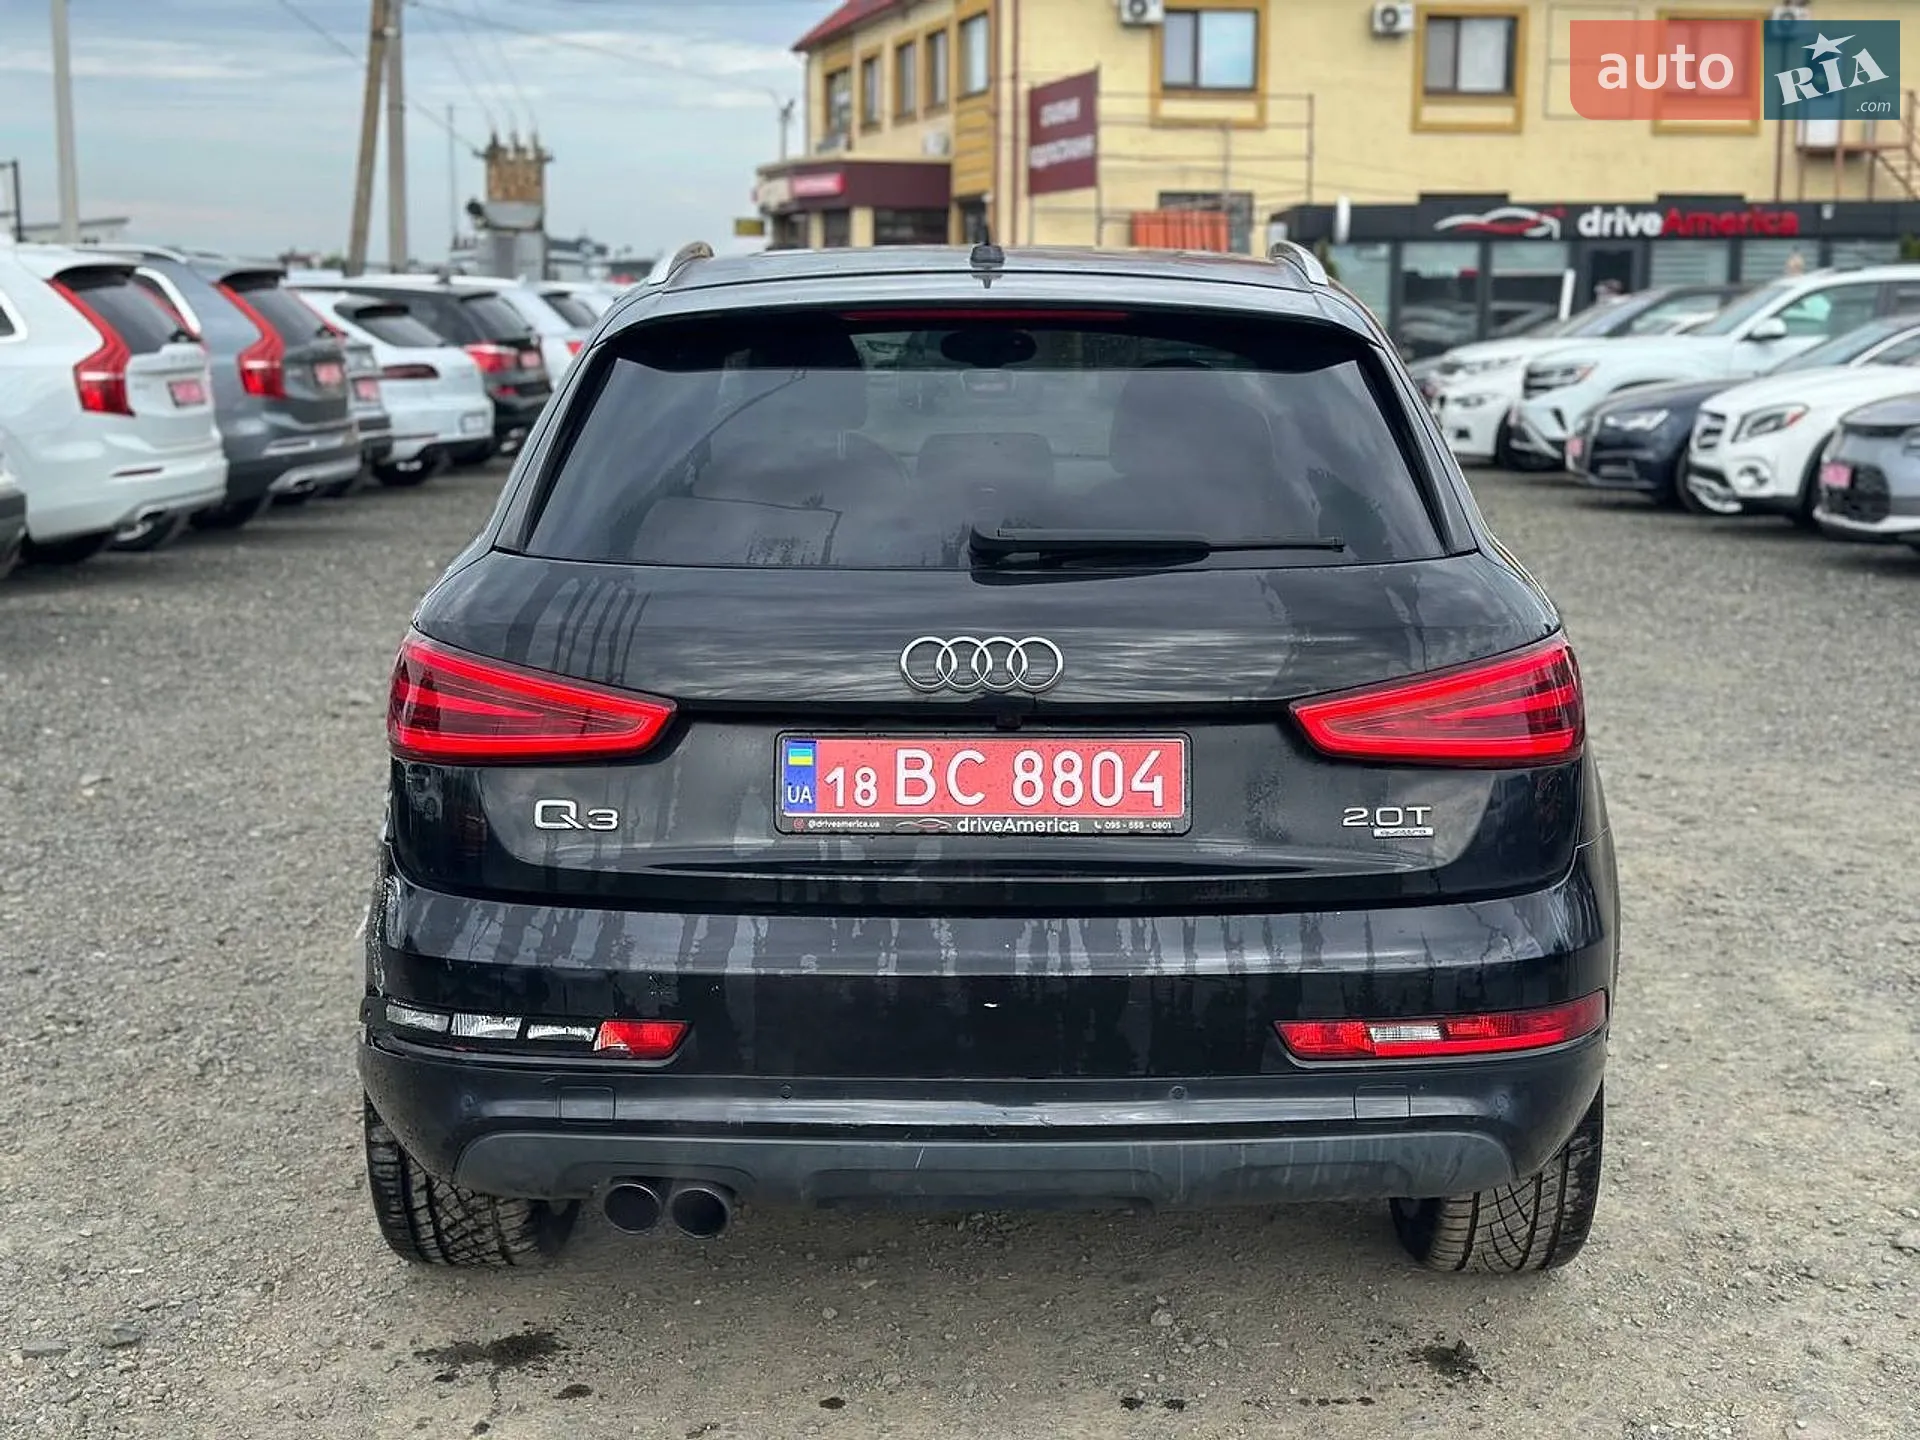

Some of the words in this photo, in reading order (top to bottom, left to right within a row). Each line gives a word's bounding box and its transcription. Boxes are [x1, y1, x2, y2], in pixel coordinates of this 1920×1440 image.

[1577, 206, 1799, 237] driveAmerica
[824, 766, 879, 807] 18
[895, 748, 987, 807] BC
[1011, 748, 1164, 807] 8804
[787, 785, 813, 804] UA
[534, 798, 619, 831] Q3
[957, 817, 1080, 834] driveAmerica
